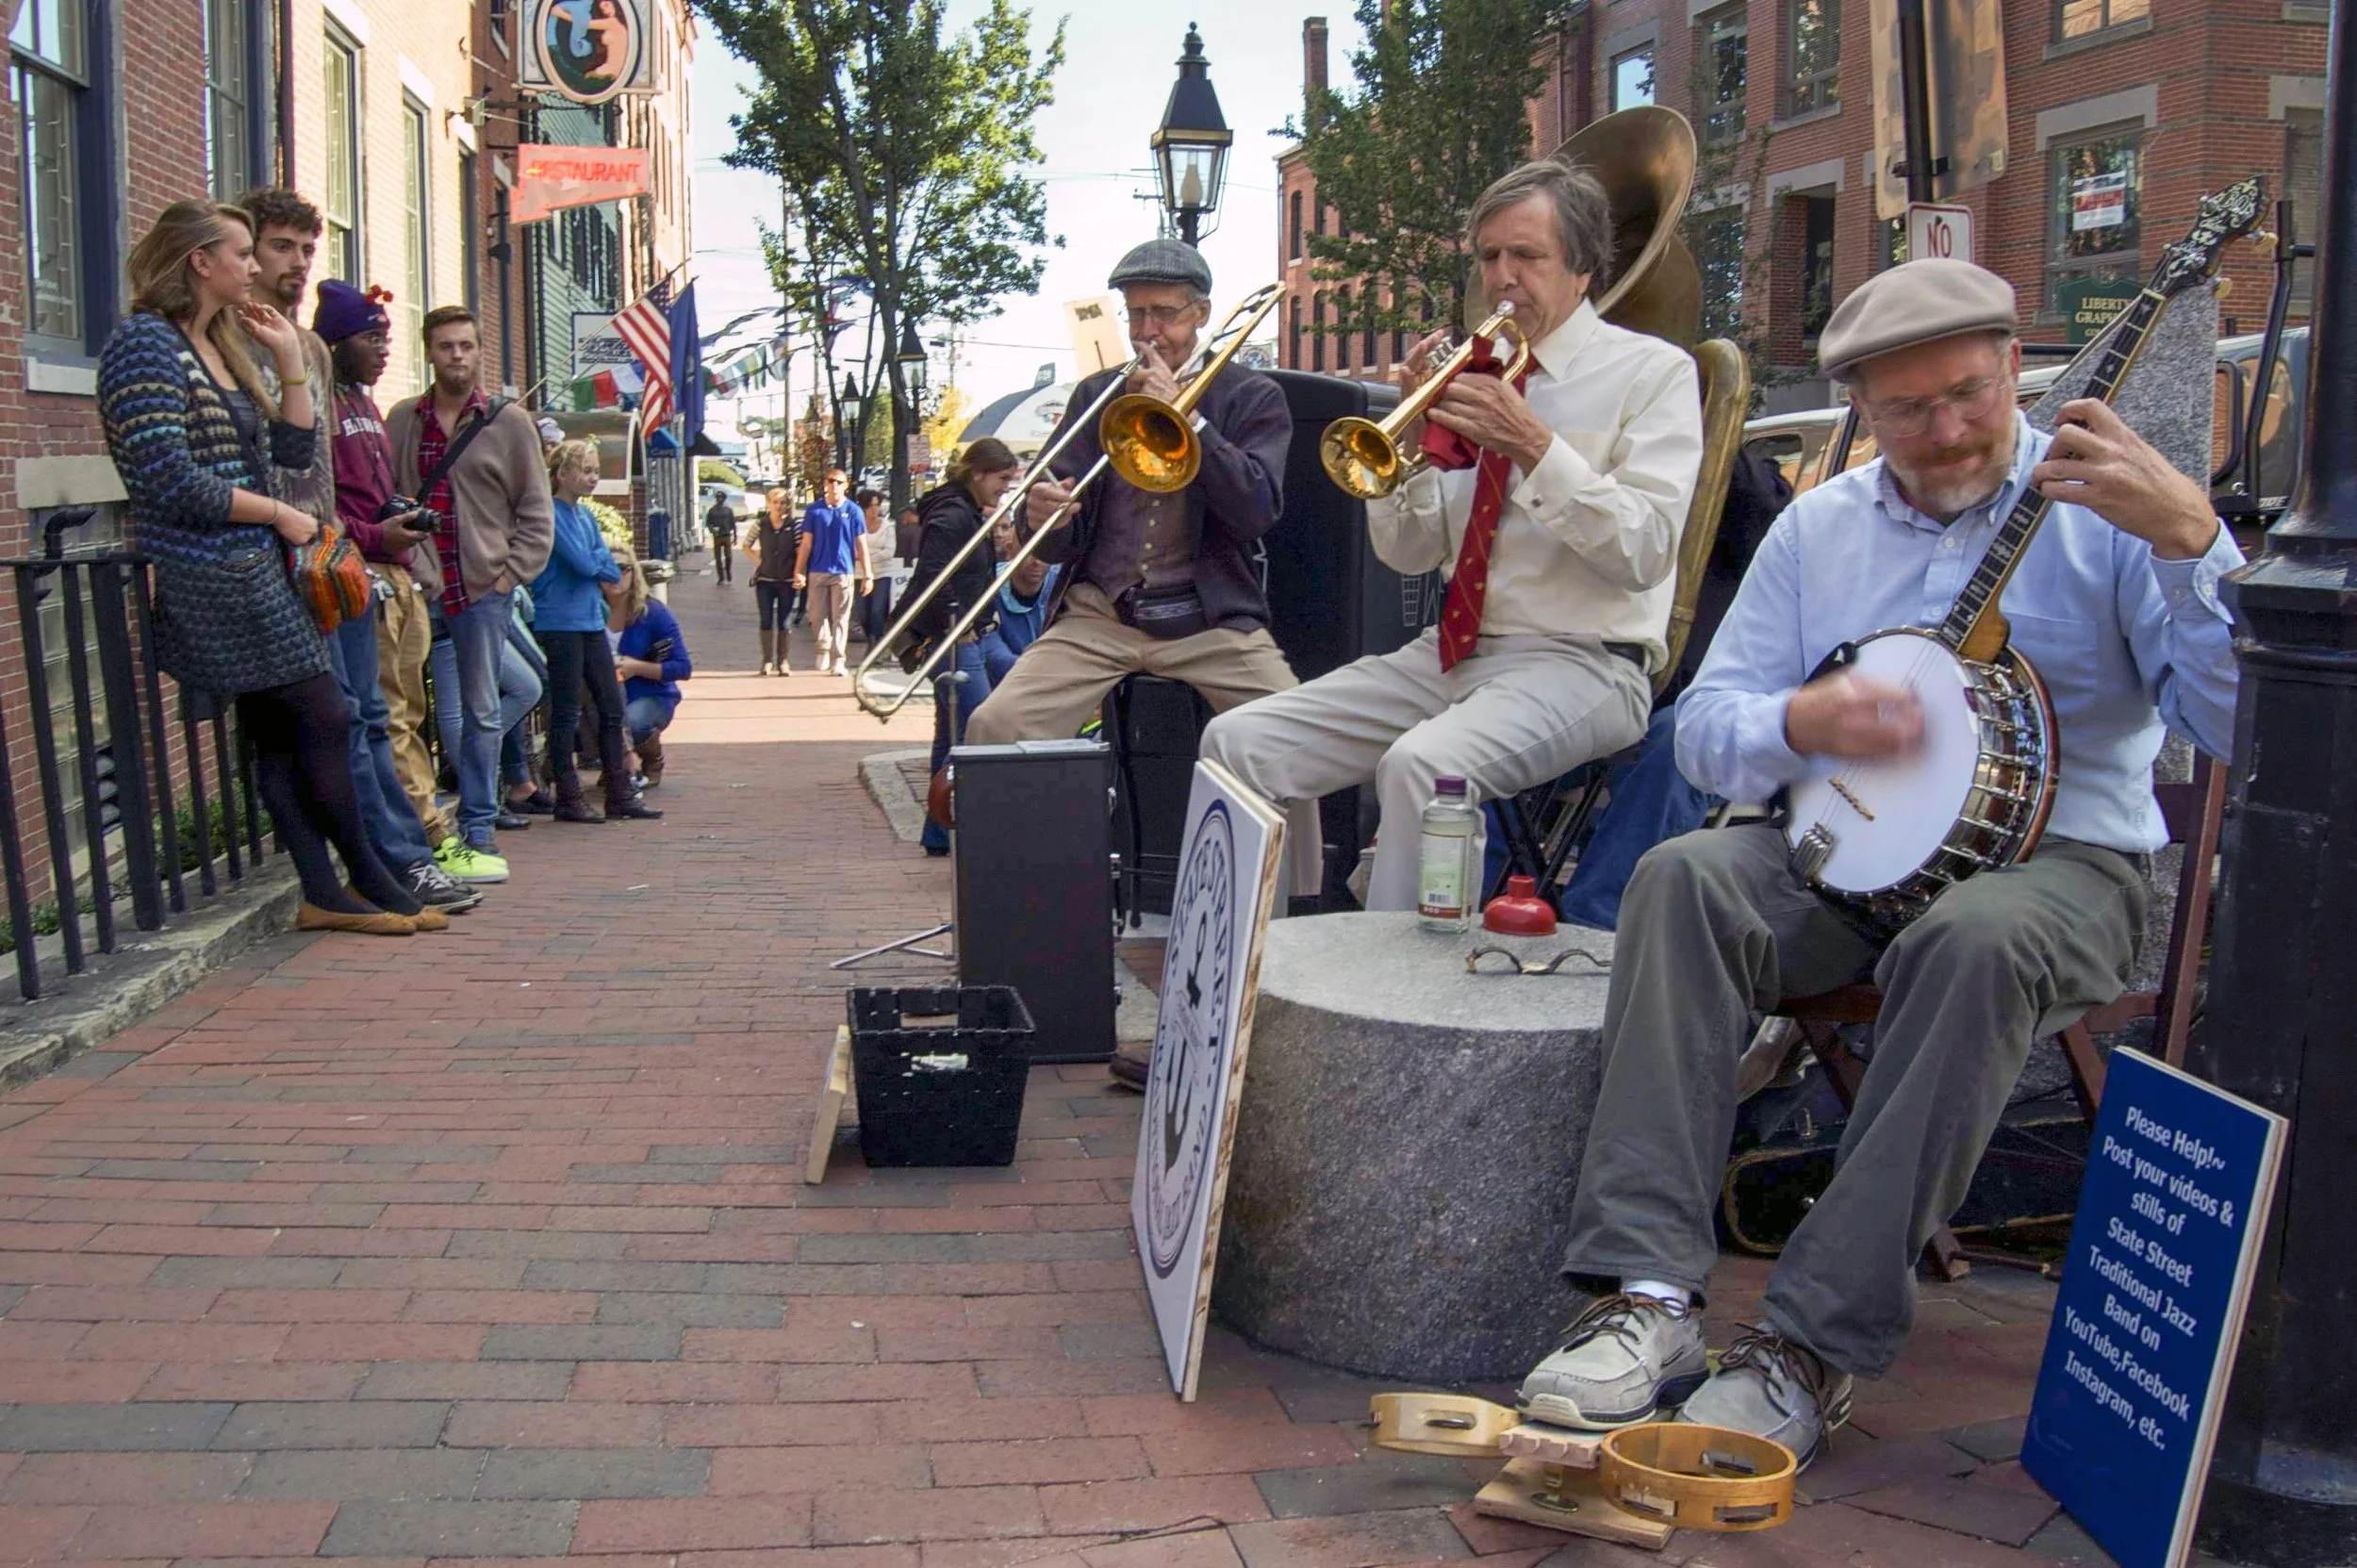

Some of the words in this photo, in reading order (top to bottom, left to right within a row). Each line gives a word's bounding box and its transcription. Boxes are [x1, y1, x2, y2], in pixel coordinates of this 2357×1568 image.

[529, 159, 640, 183] RESTAURANT
[1927, 222, 1953, 258] NO
[1171, 837, 1211, 978] STATE
[1207, 838, 1228, 1065] STREET
[2125, 1106, 2171, 1147] Please
[2102, 1135, 2134, 1169] Post
[2134, 1157, 2168, 1187] your
[2169, 1175, 2218, 1216] videos
[2220, 1200, 2234, 1228] &
[2131, 1192, 2167, 1225] stills
[2167, 1213, 2186, 1235] of
[2107, 1216, 2145, 1256] State
[2145, 1241, 2194, 1288] Street
[2089, 1245, 2163, 1312] Traditional
[2161, 1296, 2197, 1337] Jazz
[2103, 1293, 2142, 1335] Band
[2140, 1325, 2161, 1351] on
[2065, 1350, 2136, 1429] Instagram,
[2138, 1416, 2166, 1451] etc.
